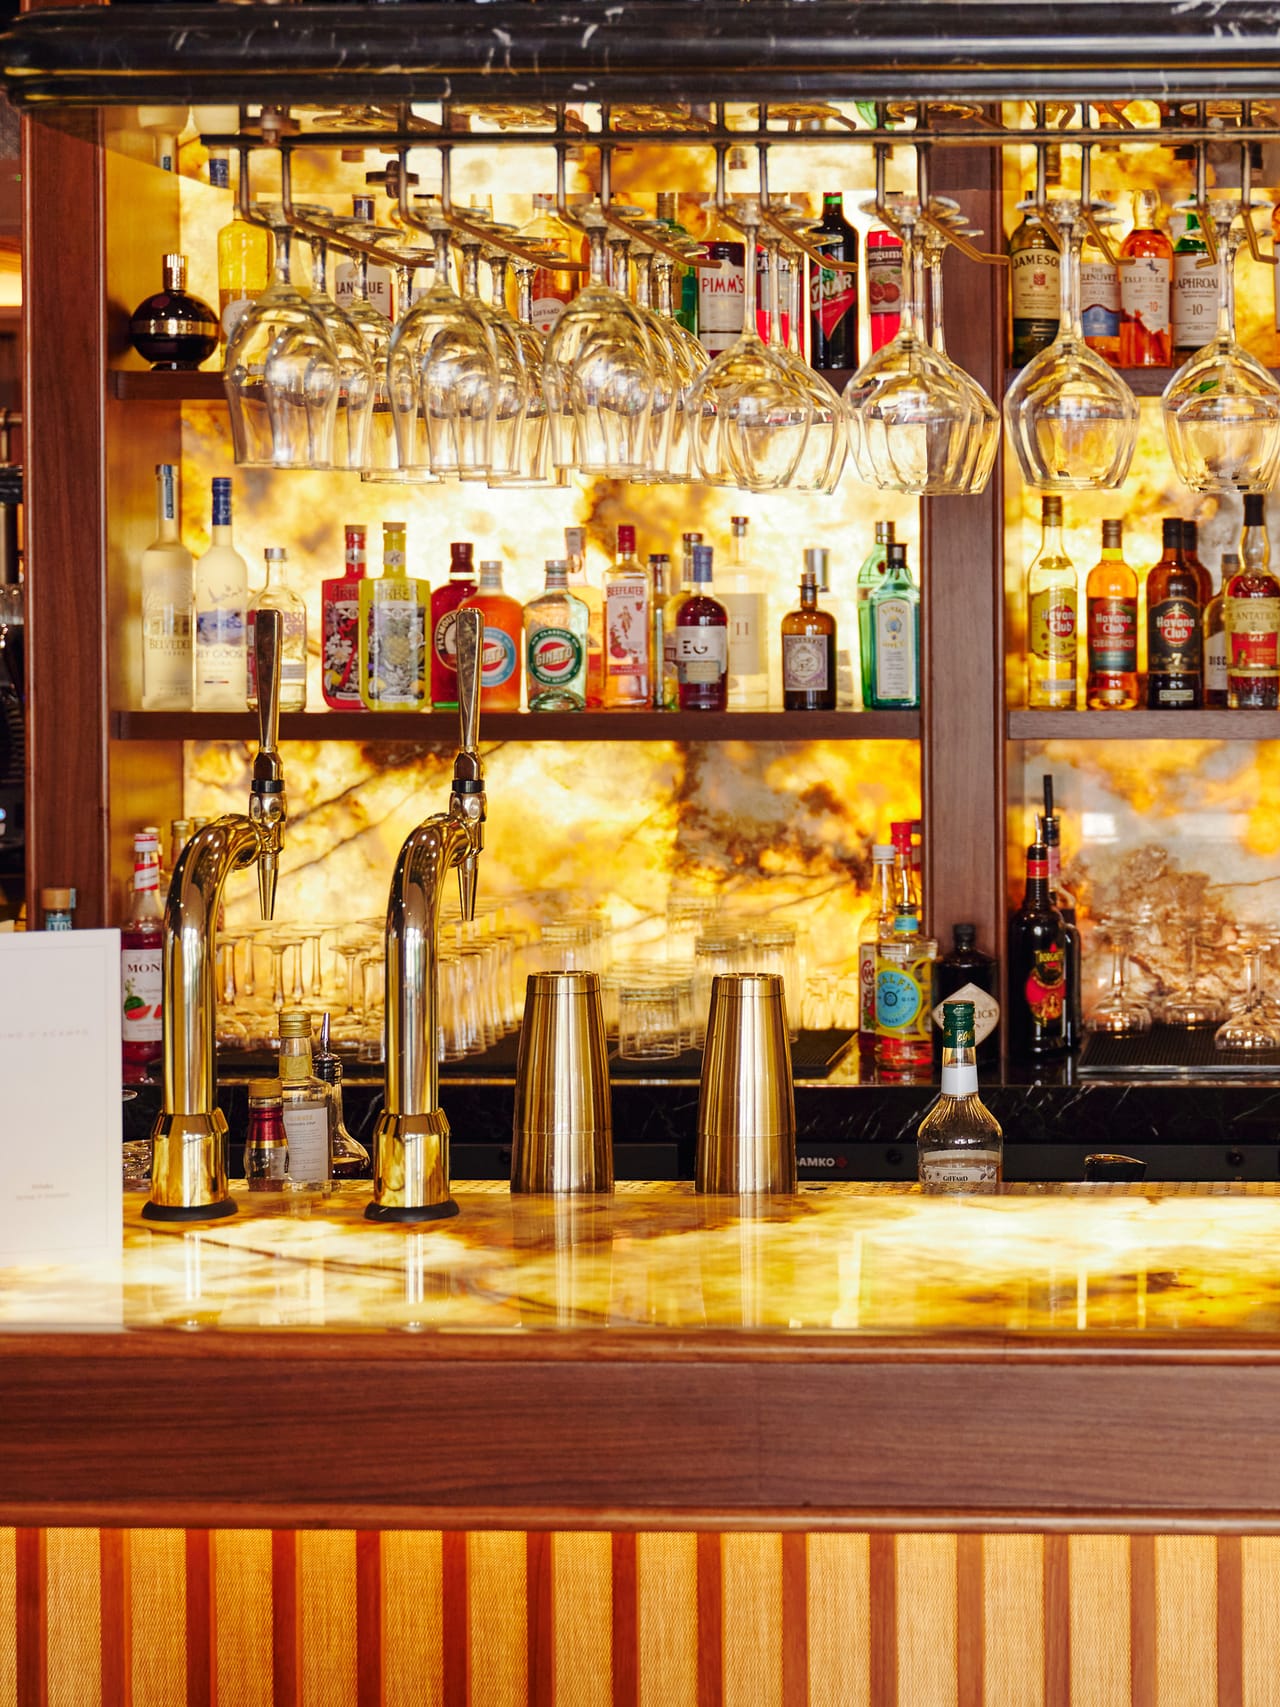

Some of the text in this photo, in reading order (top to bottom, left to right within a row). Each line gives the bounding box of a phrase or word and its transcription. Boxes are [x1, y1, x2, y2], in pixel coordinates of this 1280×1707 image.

[1013, 254, 1057, 270] JAMESO
[701, 275, 744, 293] PIMM'S
[1192, 303, 1203, 316] 10
[607, 585, 645, 598] BEEFEATER
[1096, 612, 1132, 625] Havana
[1157, 615, 1196, 629] Havana
[436, 614, 457, 651] PLYMOUT
[1050, 621, 1073, 633] Club
[1102, 622, 1125, 634] Club
[1163, 626, 1189, 639] Club
[535, 645, 573, 667] GINATO
[1171, 653, 1182, 666] 7
[127, 962, 161, 973] MON
[796, 1157, 836, 1168] AMKO
